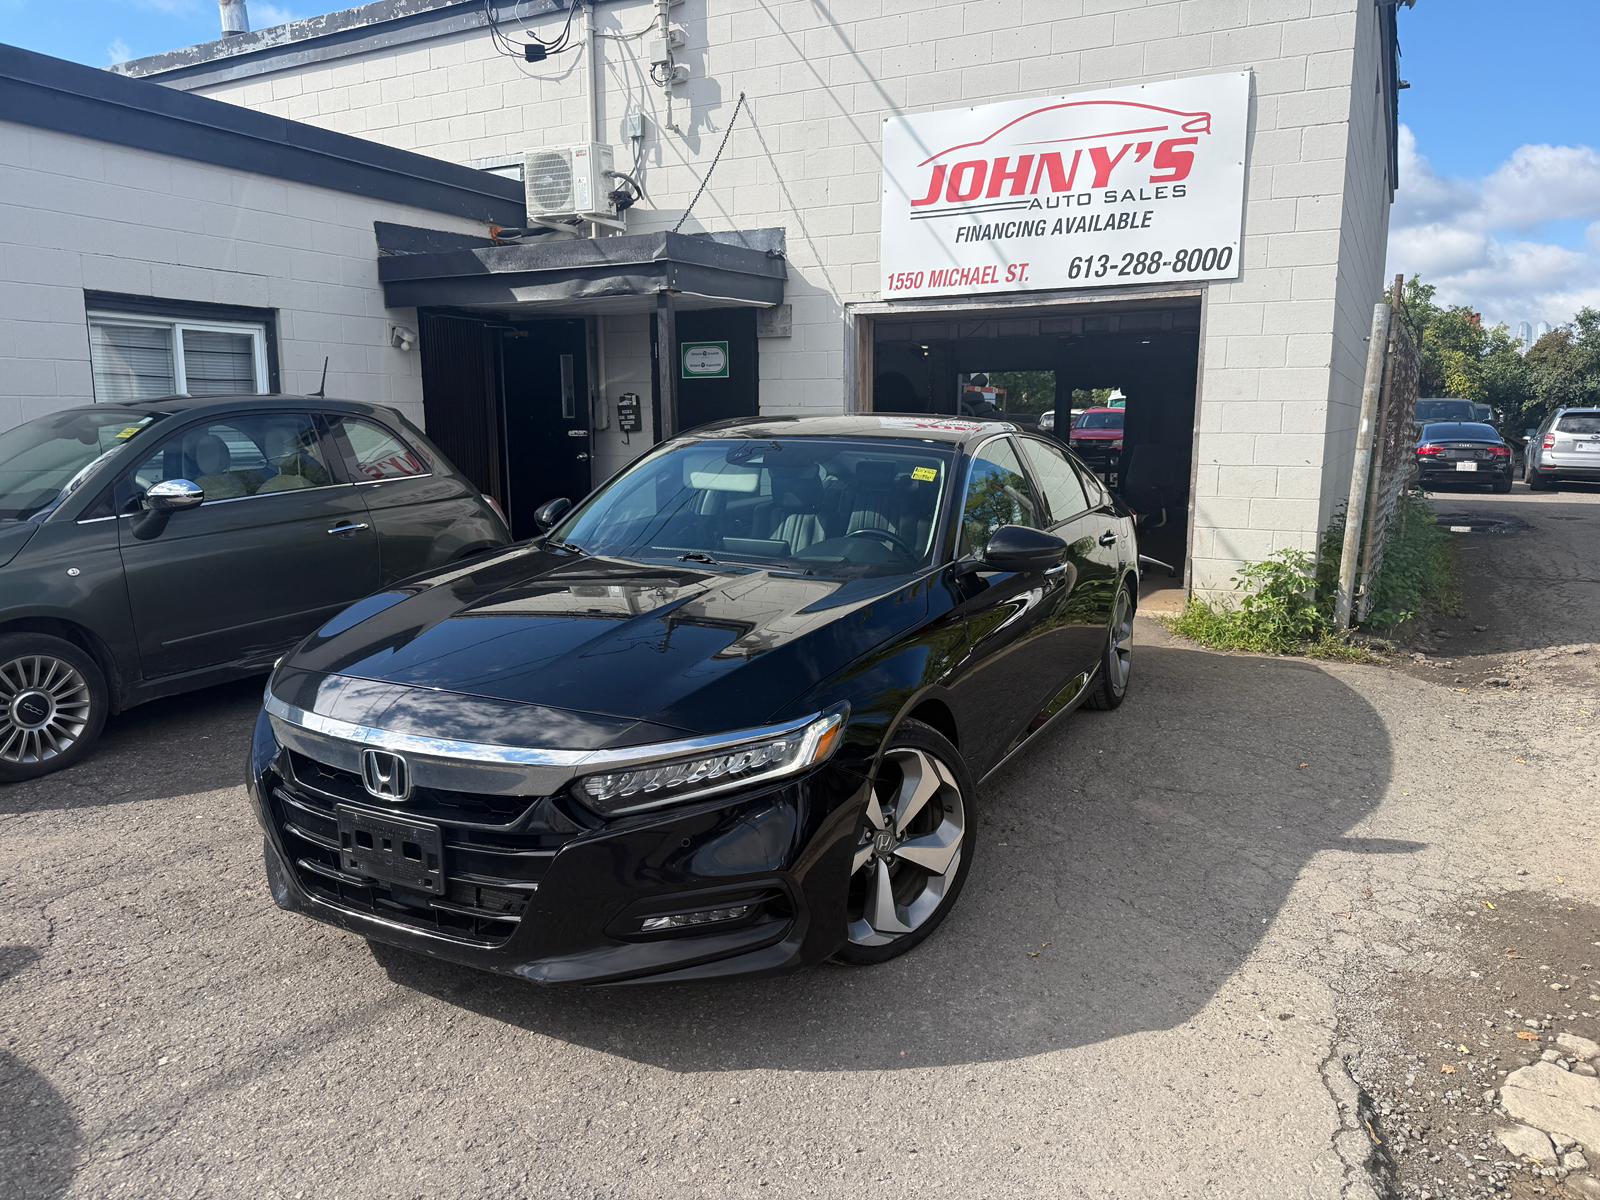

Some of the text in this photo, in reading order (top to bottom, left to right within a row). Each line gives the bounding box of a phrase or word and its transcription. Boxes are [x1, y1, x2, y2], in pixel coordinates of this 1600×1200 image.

[911, 136, 1199, 207] JOHNY'S
[1028, 184, 1187, 211] AUTO SALES
[955, 210, 1154, 243] FINANCING AVAILABLE
[887, 262, 1030, 291] 1550 MICHAEL ST.
[1067, 246, 1233, 280] 613-288-8000
